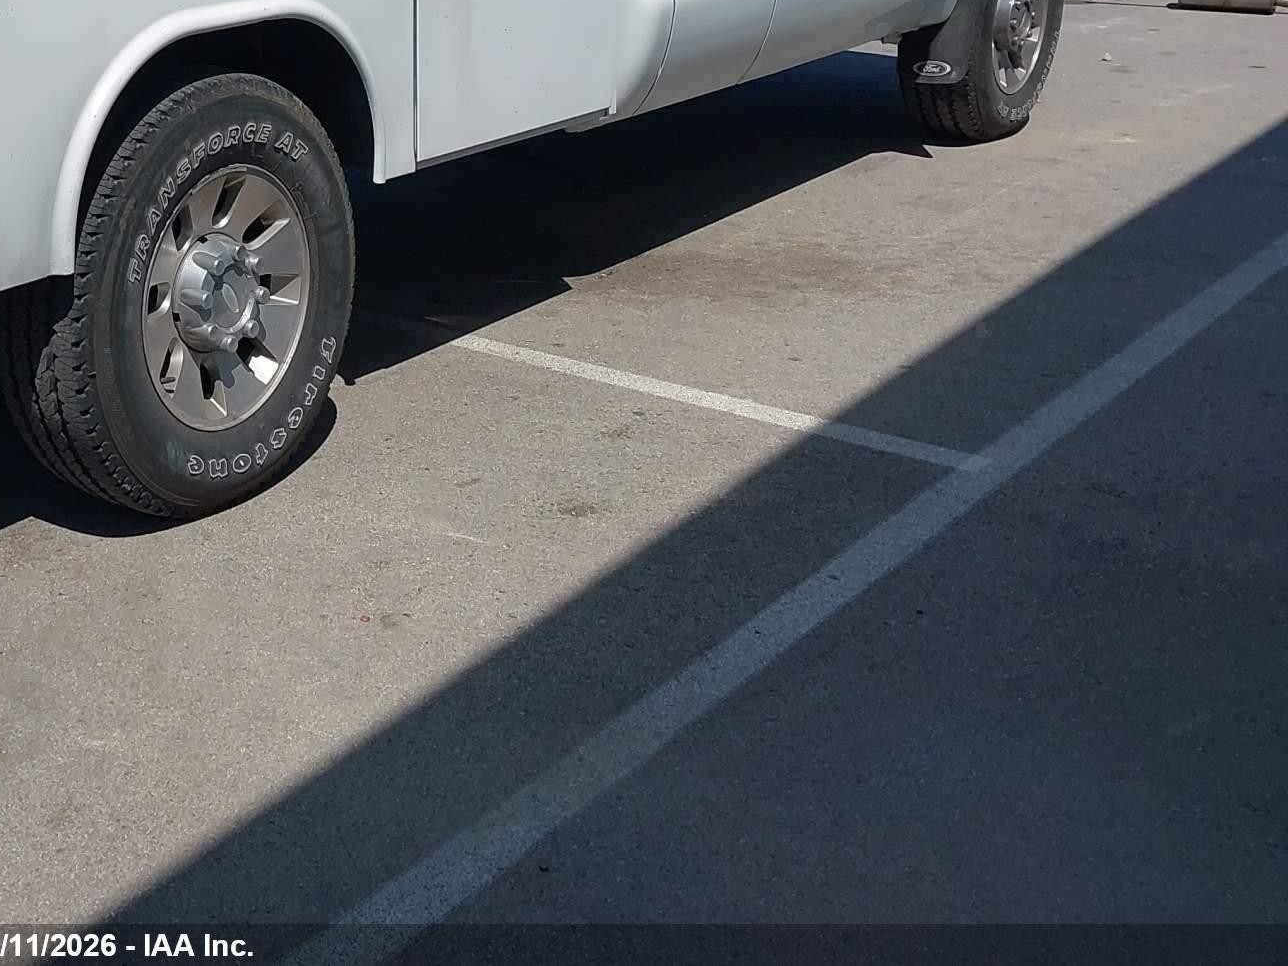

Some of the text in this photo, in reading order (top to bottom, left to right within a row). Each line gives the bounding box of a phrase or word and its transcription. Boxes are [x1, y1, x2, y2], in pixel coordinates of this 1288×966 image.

[127, 122, 309, 284] TRANSFORCE AT
[187, 336, 337, 479] Firestone
